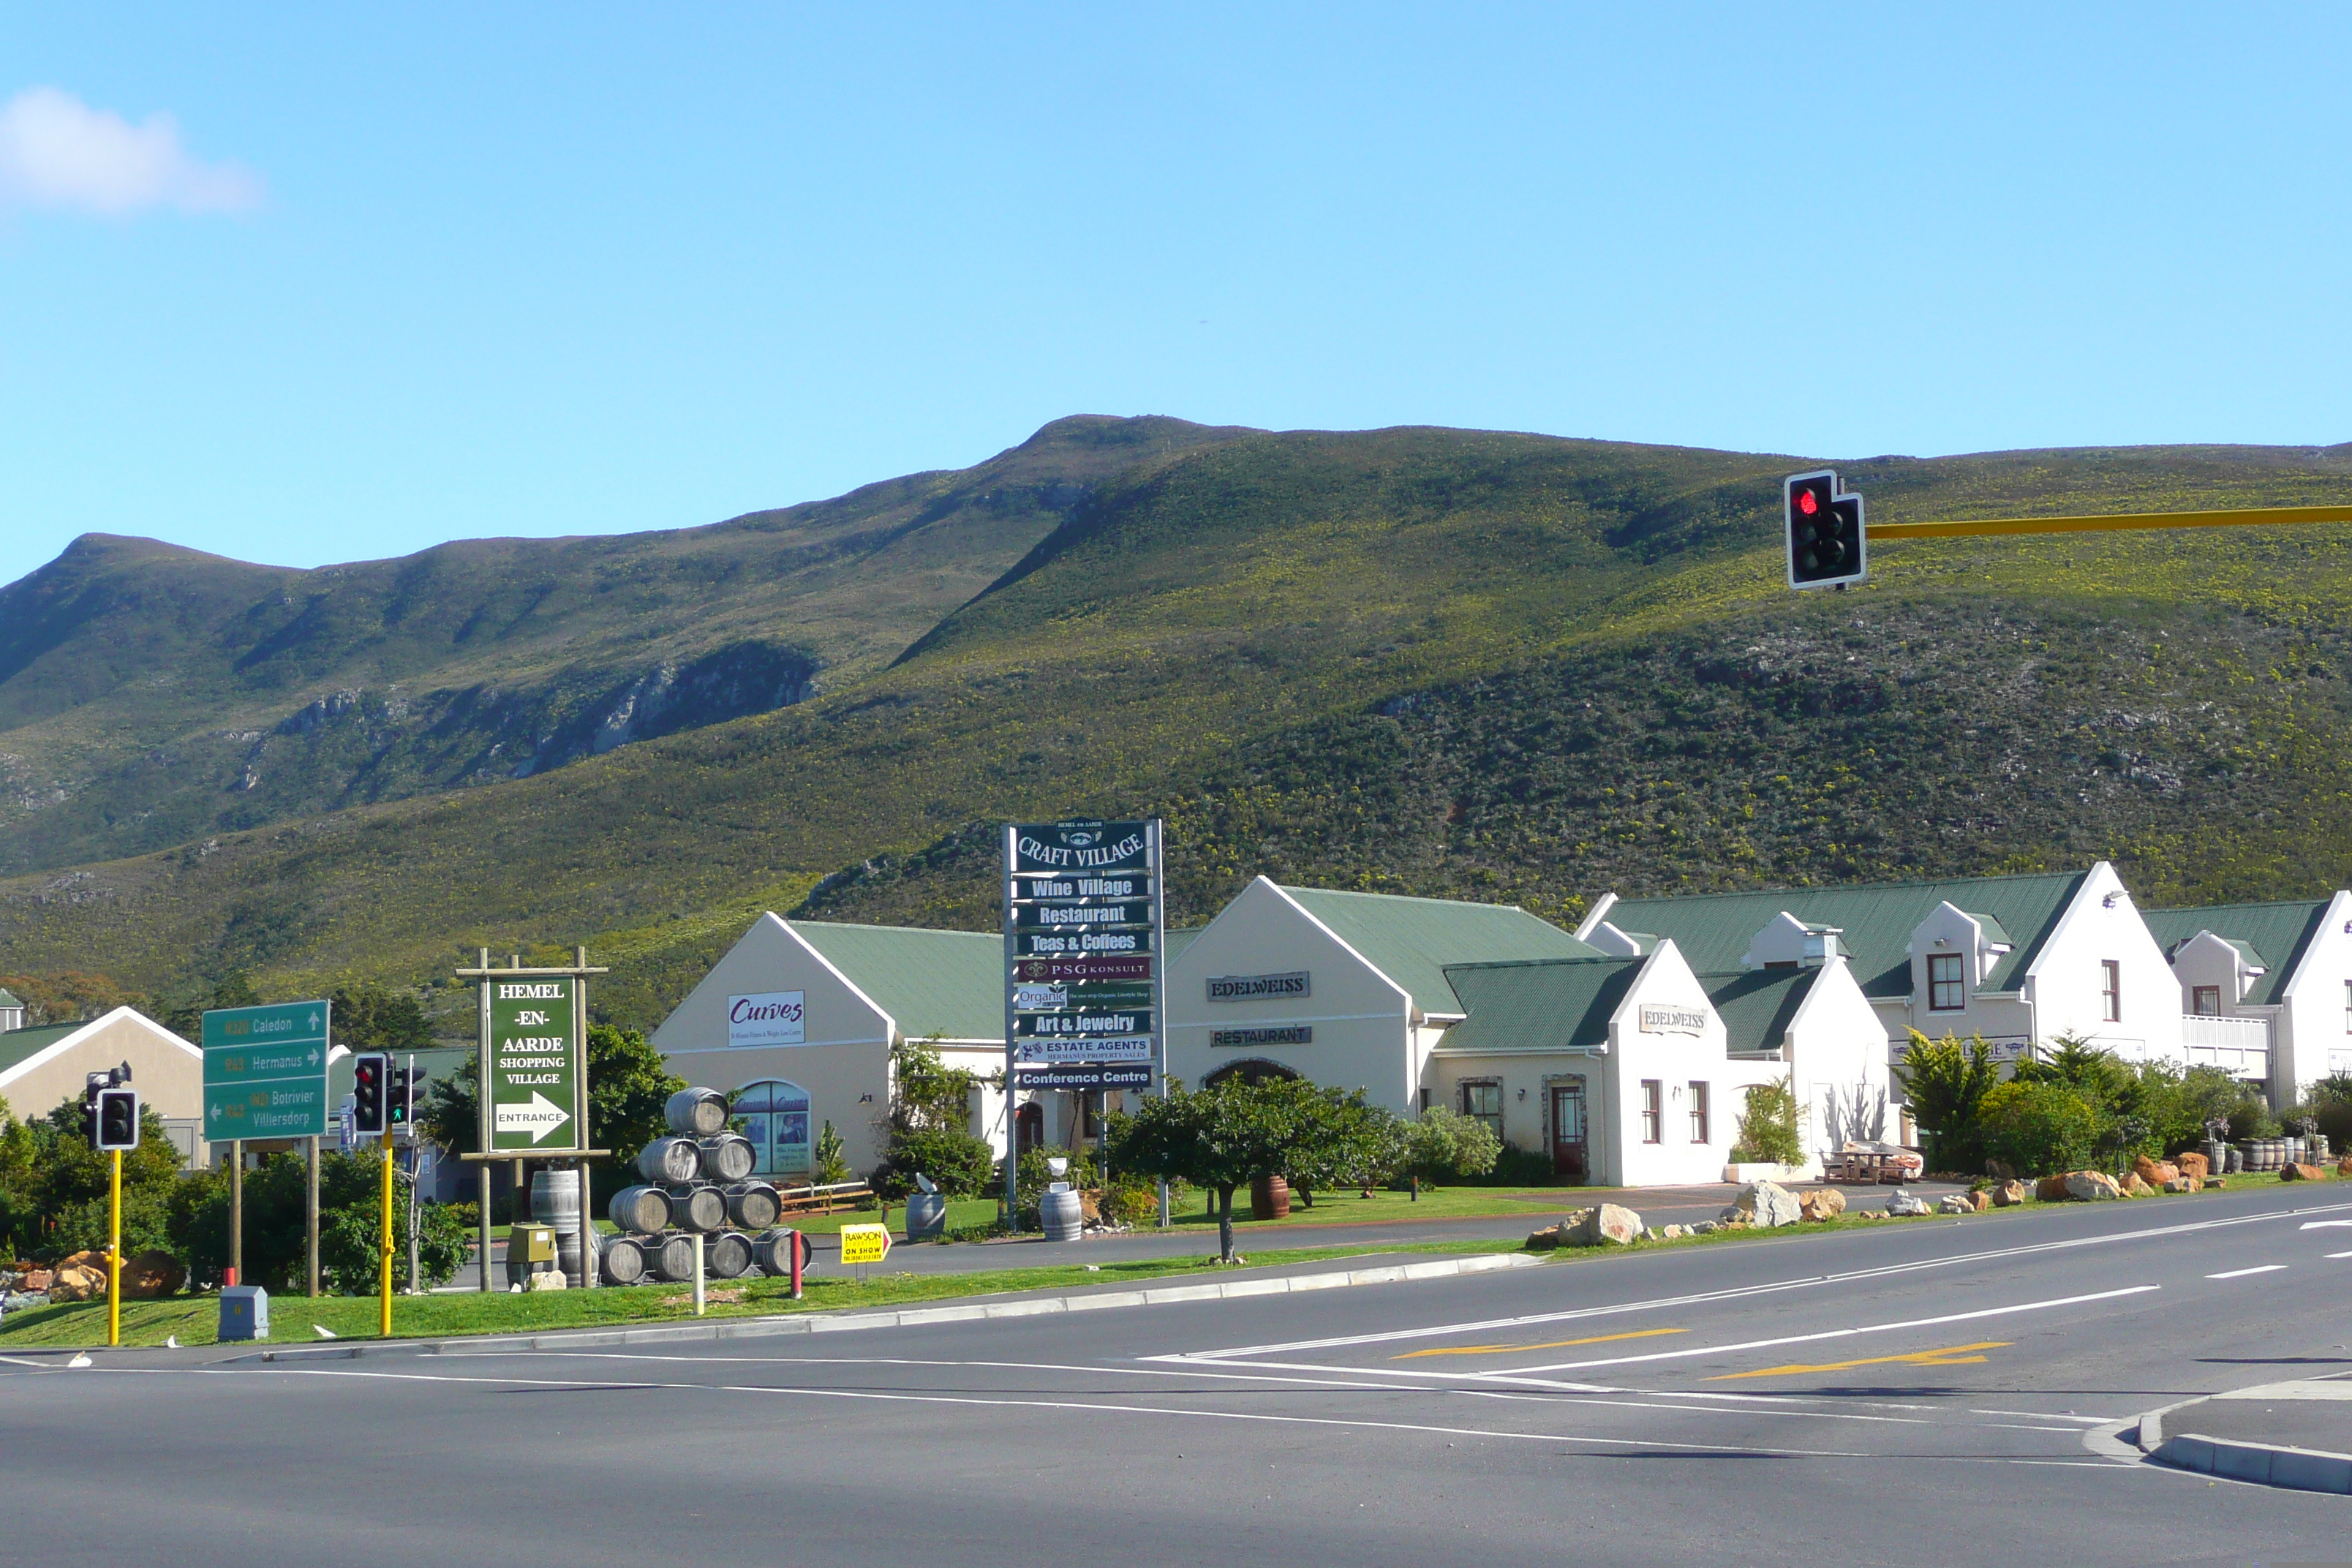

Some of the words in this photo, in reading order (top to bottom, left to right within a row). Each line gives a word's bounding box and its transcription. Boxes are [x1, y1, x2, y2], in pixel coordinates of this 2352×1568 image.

[1018, 837, 1071, 866] CRAFT
[1076, 833, 1144, 867] VILLAGE
[1032, 881, 1072, 897] Wine
[1078, 879, 1132, 897] Village
[1040, 906, 1126, 924] Restaurant
[1031, 935, 1065, 951] Teas
[1068, 937, 1079, 950] &
[1082, 934, 1136, 949] Coffees
[1052, 965, 1086, 974] PSG
[499, 984, 564, 998] HEMEL
[1211, 978, 1304, 996] EDELWEISS
[1020, 991, 1065, 1005] Organic
[730, 998, 802, 1024] Curves
[253, 1017, 292, 1033] Caledon
[1036, 1016, 1058, 1032] Art
[1062, 1017, 1072, 1030] &
[1076, 1014, 1134, 1032] Jewelry
[1645, 1011, 1704, 1029] EDELWEISS
[1214, 1028, 1305, 1044] RESTAURANT
[502, 1037, 563, 1052] AARDE
[1047, 1042, 1093, 1052] ESTATE
[1097, 1041, 1146, 1050] AGENTS
[253, 1056, 302, 1070] Hermanus
[500, 1058, 565, 1068] SHOPPING
[506, 1074, 559, 1084] VILLAGE
[1023, 1073, 1099, 1084] Conference
[1103, 1071, 1148, 1082] Centre
[272, 1090, 314, 1106] Botrivier
[253, 1112, 309, 1127] Villiersdorp
[499, 1113, 562, 1122] ENTRANCE
[845, 1232, 881, 1242] RAWSON
